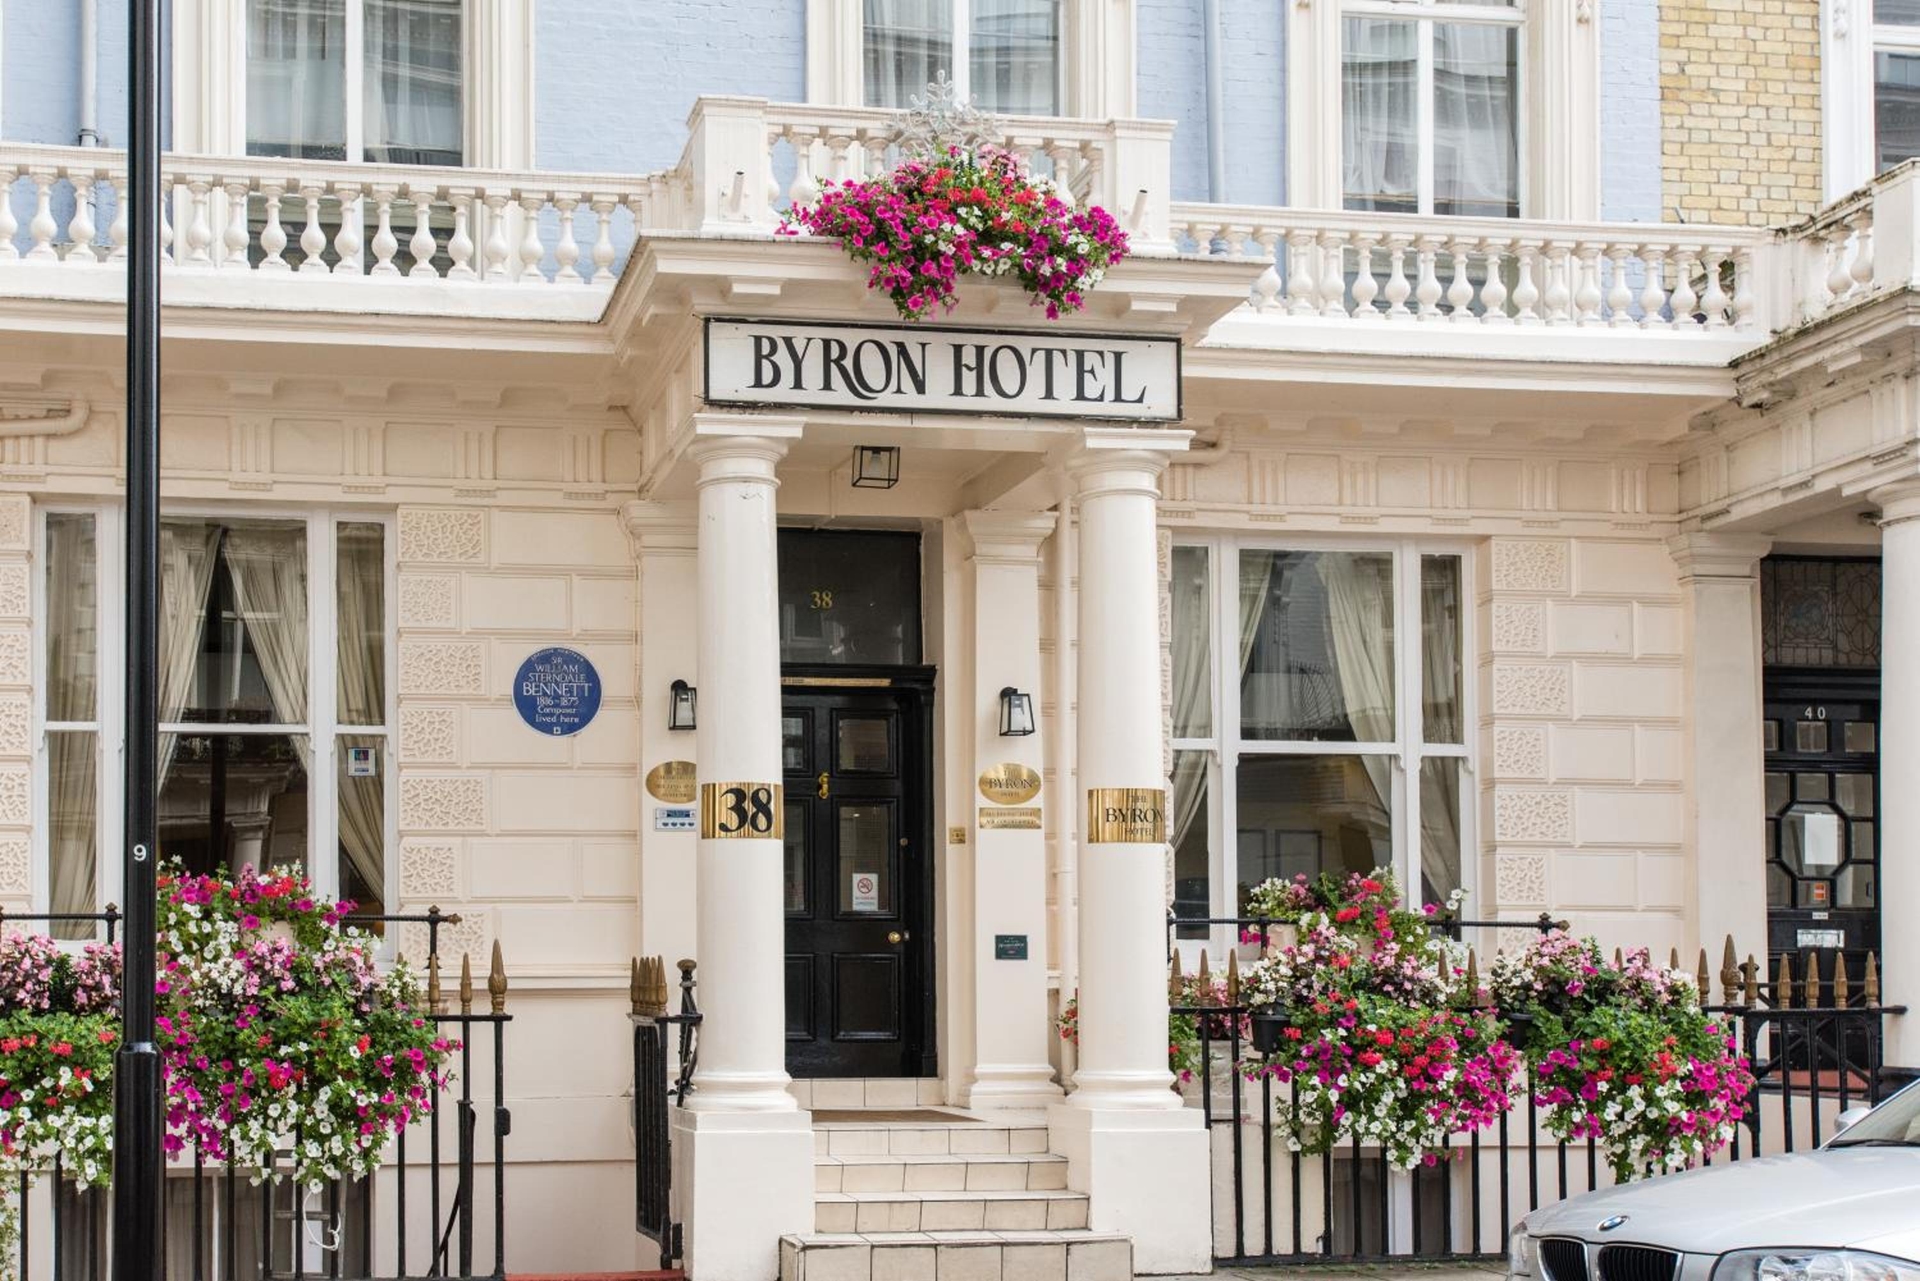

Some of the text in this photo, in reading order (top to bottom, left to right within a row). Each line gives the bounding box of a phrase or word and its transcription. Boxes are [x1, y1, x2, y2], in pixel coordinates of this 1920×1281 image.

[747, 334, 1147, 404] BYRON HOTEL
[810, 590, 833, 609] 38
[535, 664, 578, 673] WILLIAM
[528, 673, 586, 682] STERNDALE
[523, 682, 592, 697] BENNETT
[1804, 706, 1826, 720] 40
[989, 778, 1033, 789] BYRON
[718, 787, 773, 833] 38
[1105, 807, 1164, 823] BYRON
[133, 844, 147, 862] 9
